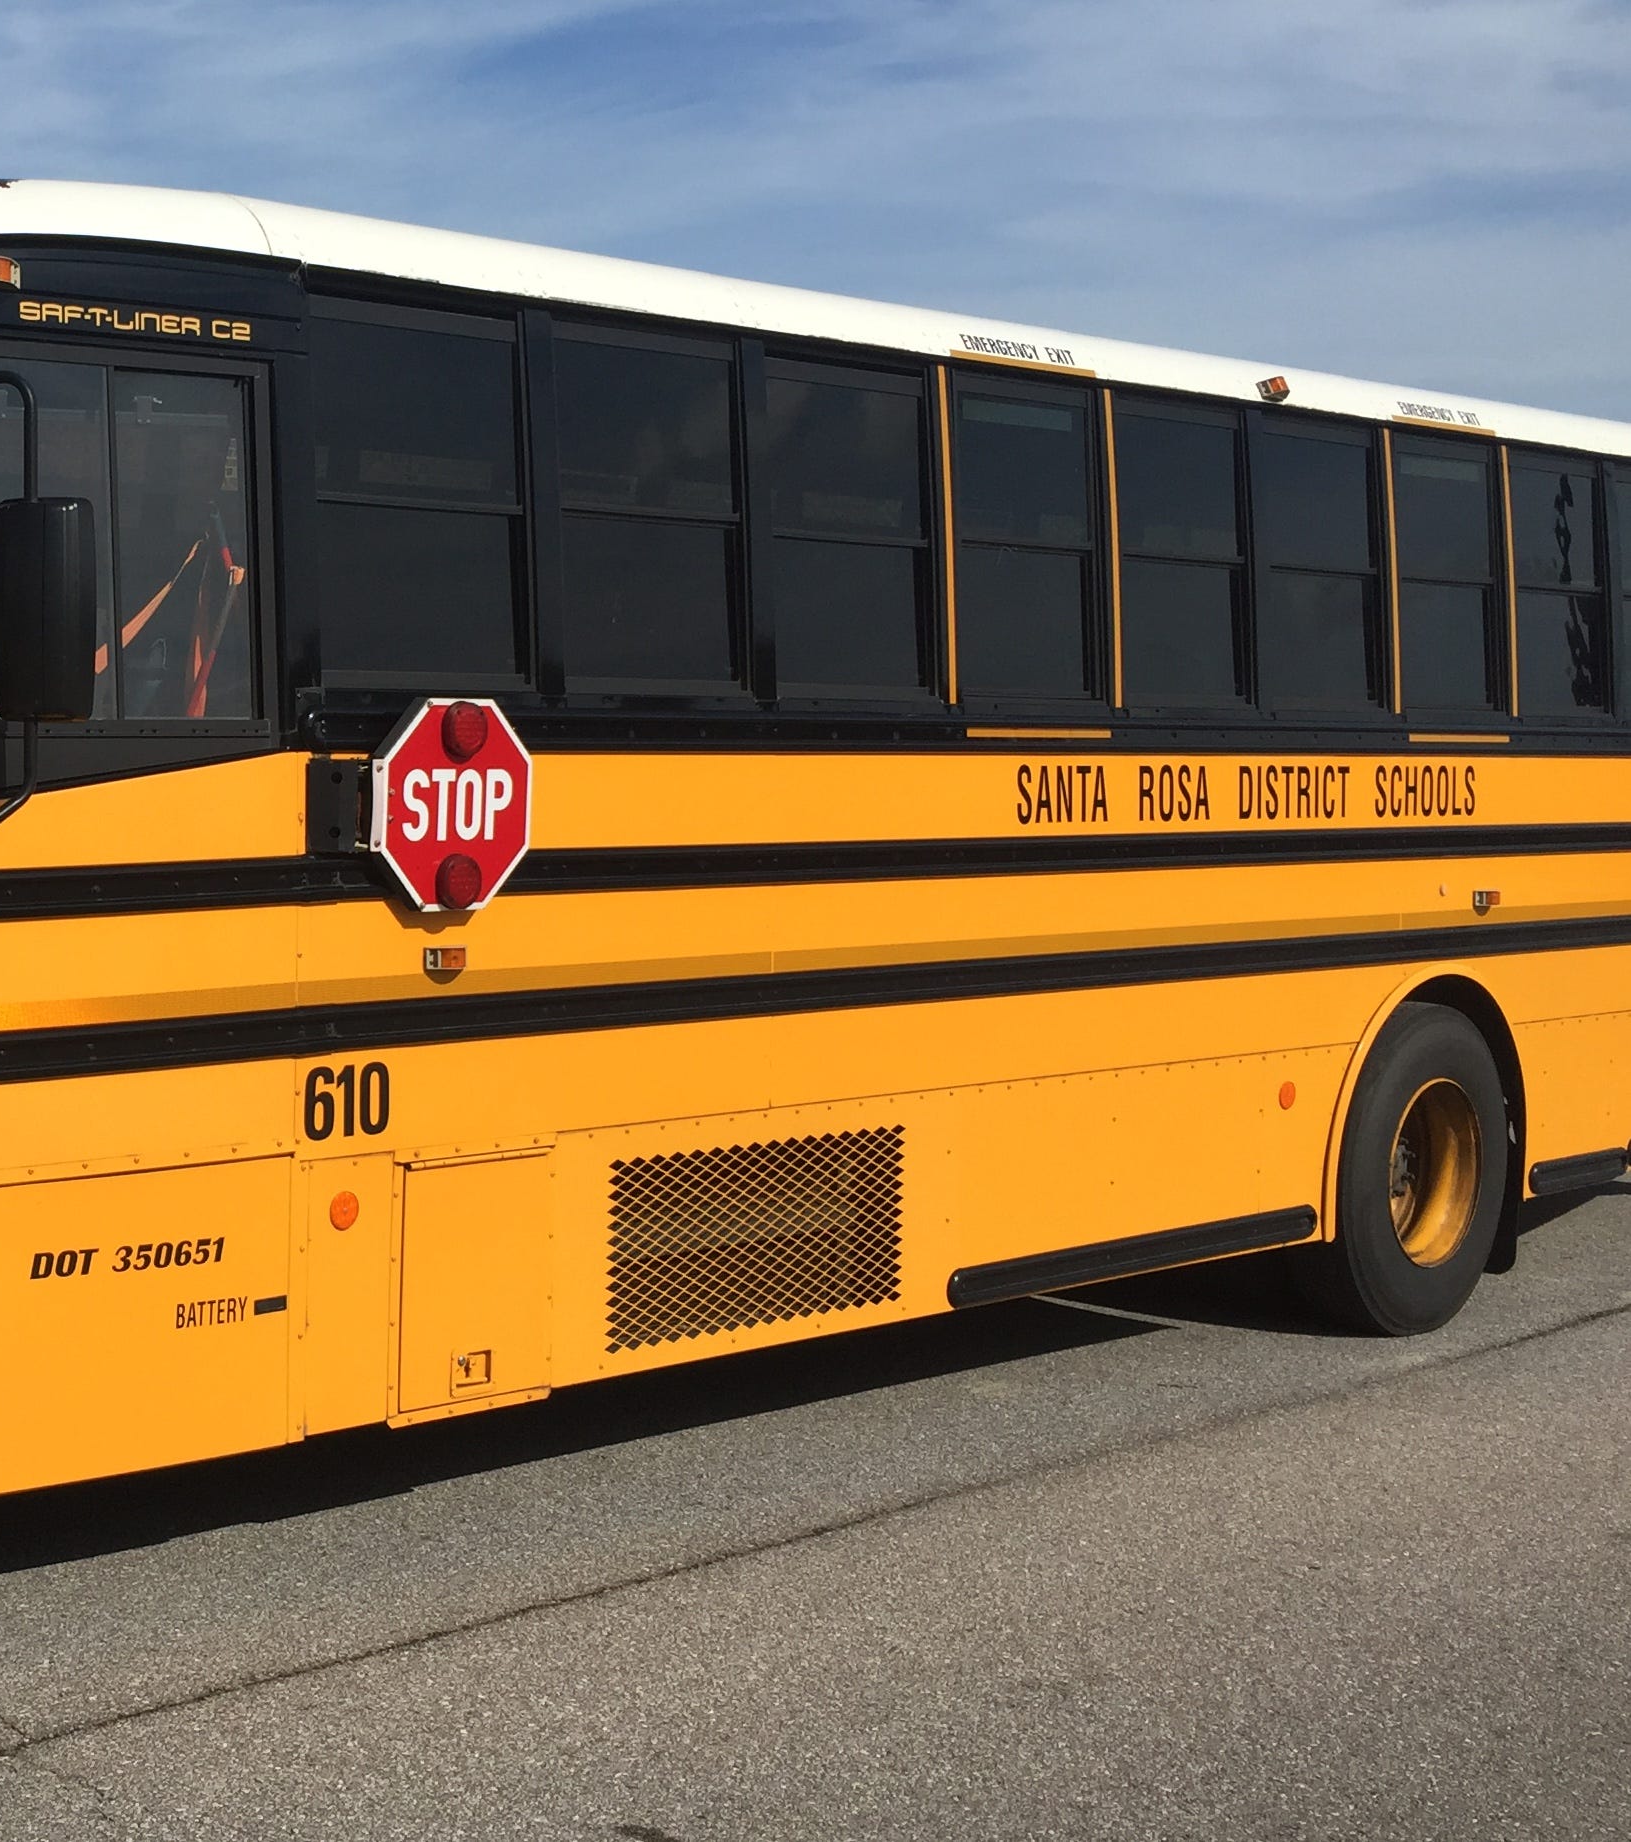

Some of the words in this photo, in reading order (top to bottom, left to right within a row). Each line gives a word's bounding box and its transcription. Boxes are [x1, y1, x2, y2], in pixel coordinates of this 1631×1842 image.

[210, 319, 251, 342] C2
[959, 334, 1040, 361] EMERGENCY
[1043, 346, 1076, 366] EXIT
[1396, 401, 1456, 422] EMERGENCY
[1457, 410, 1481, 426] EXIT
[401, 768, 513, 842] STOP
[1016, 764, 1109, 826] SANTA
[1138, 764, 1211, 821] ROSA
[1238, 764, 1351, 820] DISTRICT
[1374, 764, 1477, 819] SCHOOLS
[302, 1061, 390, 1141] 610
[29, 1247, 100, 1280] DOT
[111, 1236, 226, 1273] 350651
[175, 1295, 248, 1329] BATTERY
